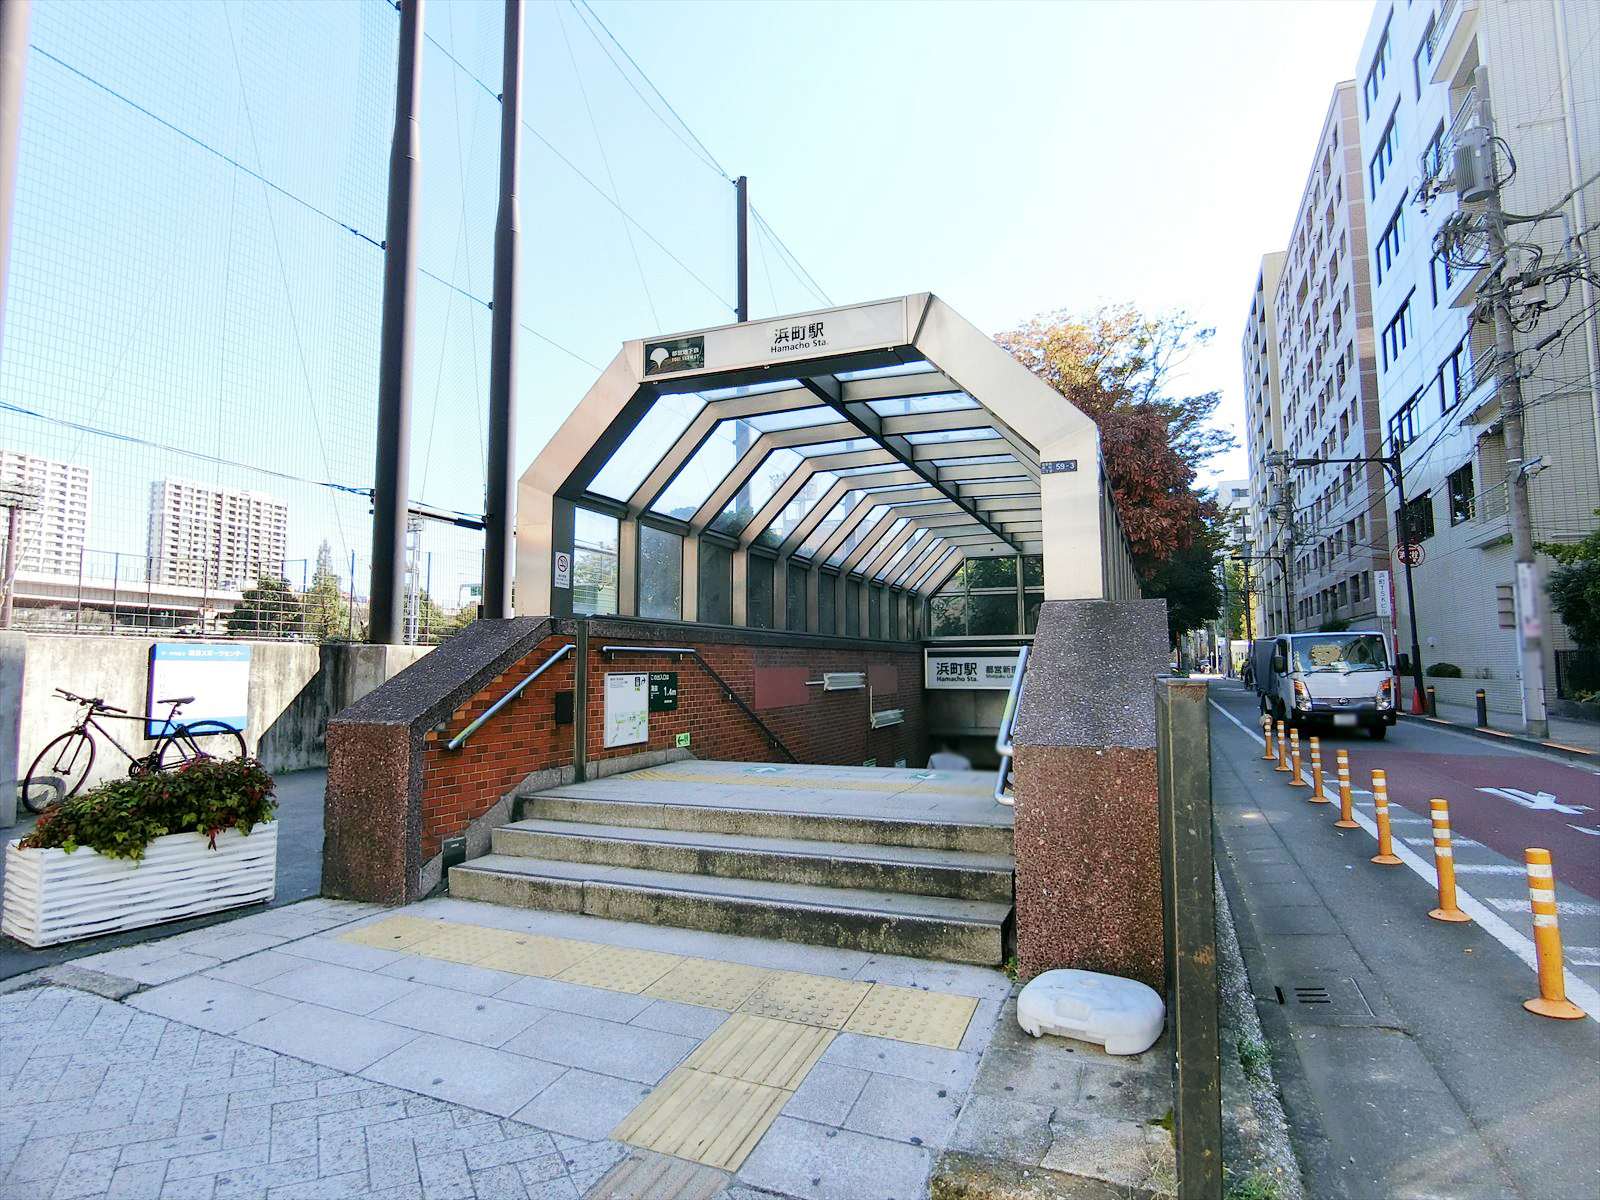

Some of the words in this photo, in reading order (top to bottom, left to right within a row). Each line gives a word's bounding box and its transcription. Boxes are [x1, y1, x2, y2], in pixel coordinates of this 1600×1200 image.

[774, 322, 824, 344] 浜町駅
[770, 342, 810, 353] Hamacho
[812, 339, 829, 347] Sta.
[1055, 462, 1075, 470] 59-3
[936, 662, 978, 675] 浜町駅
